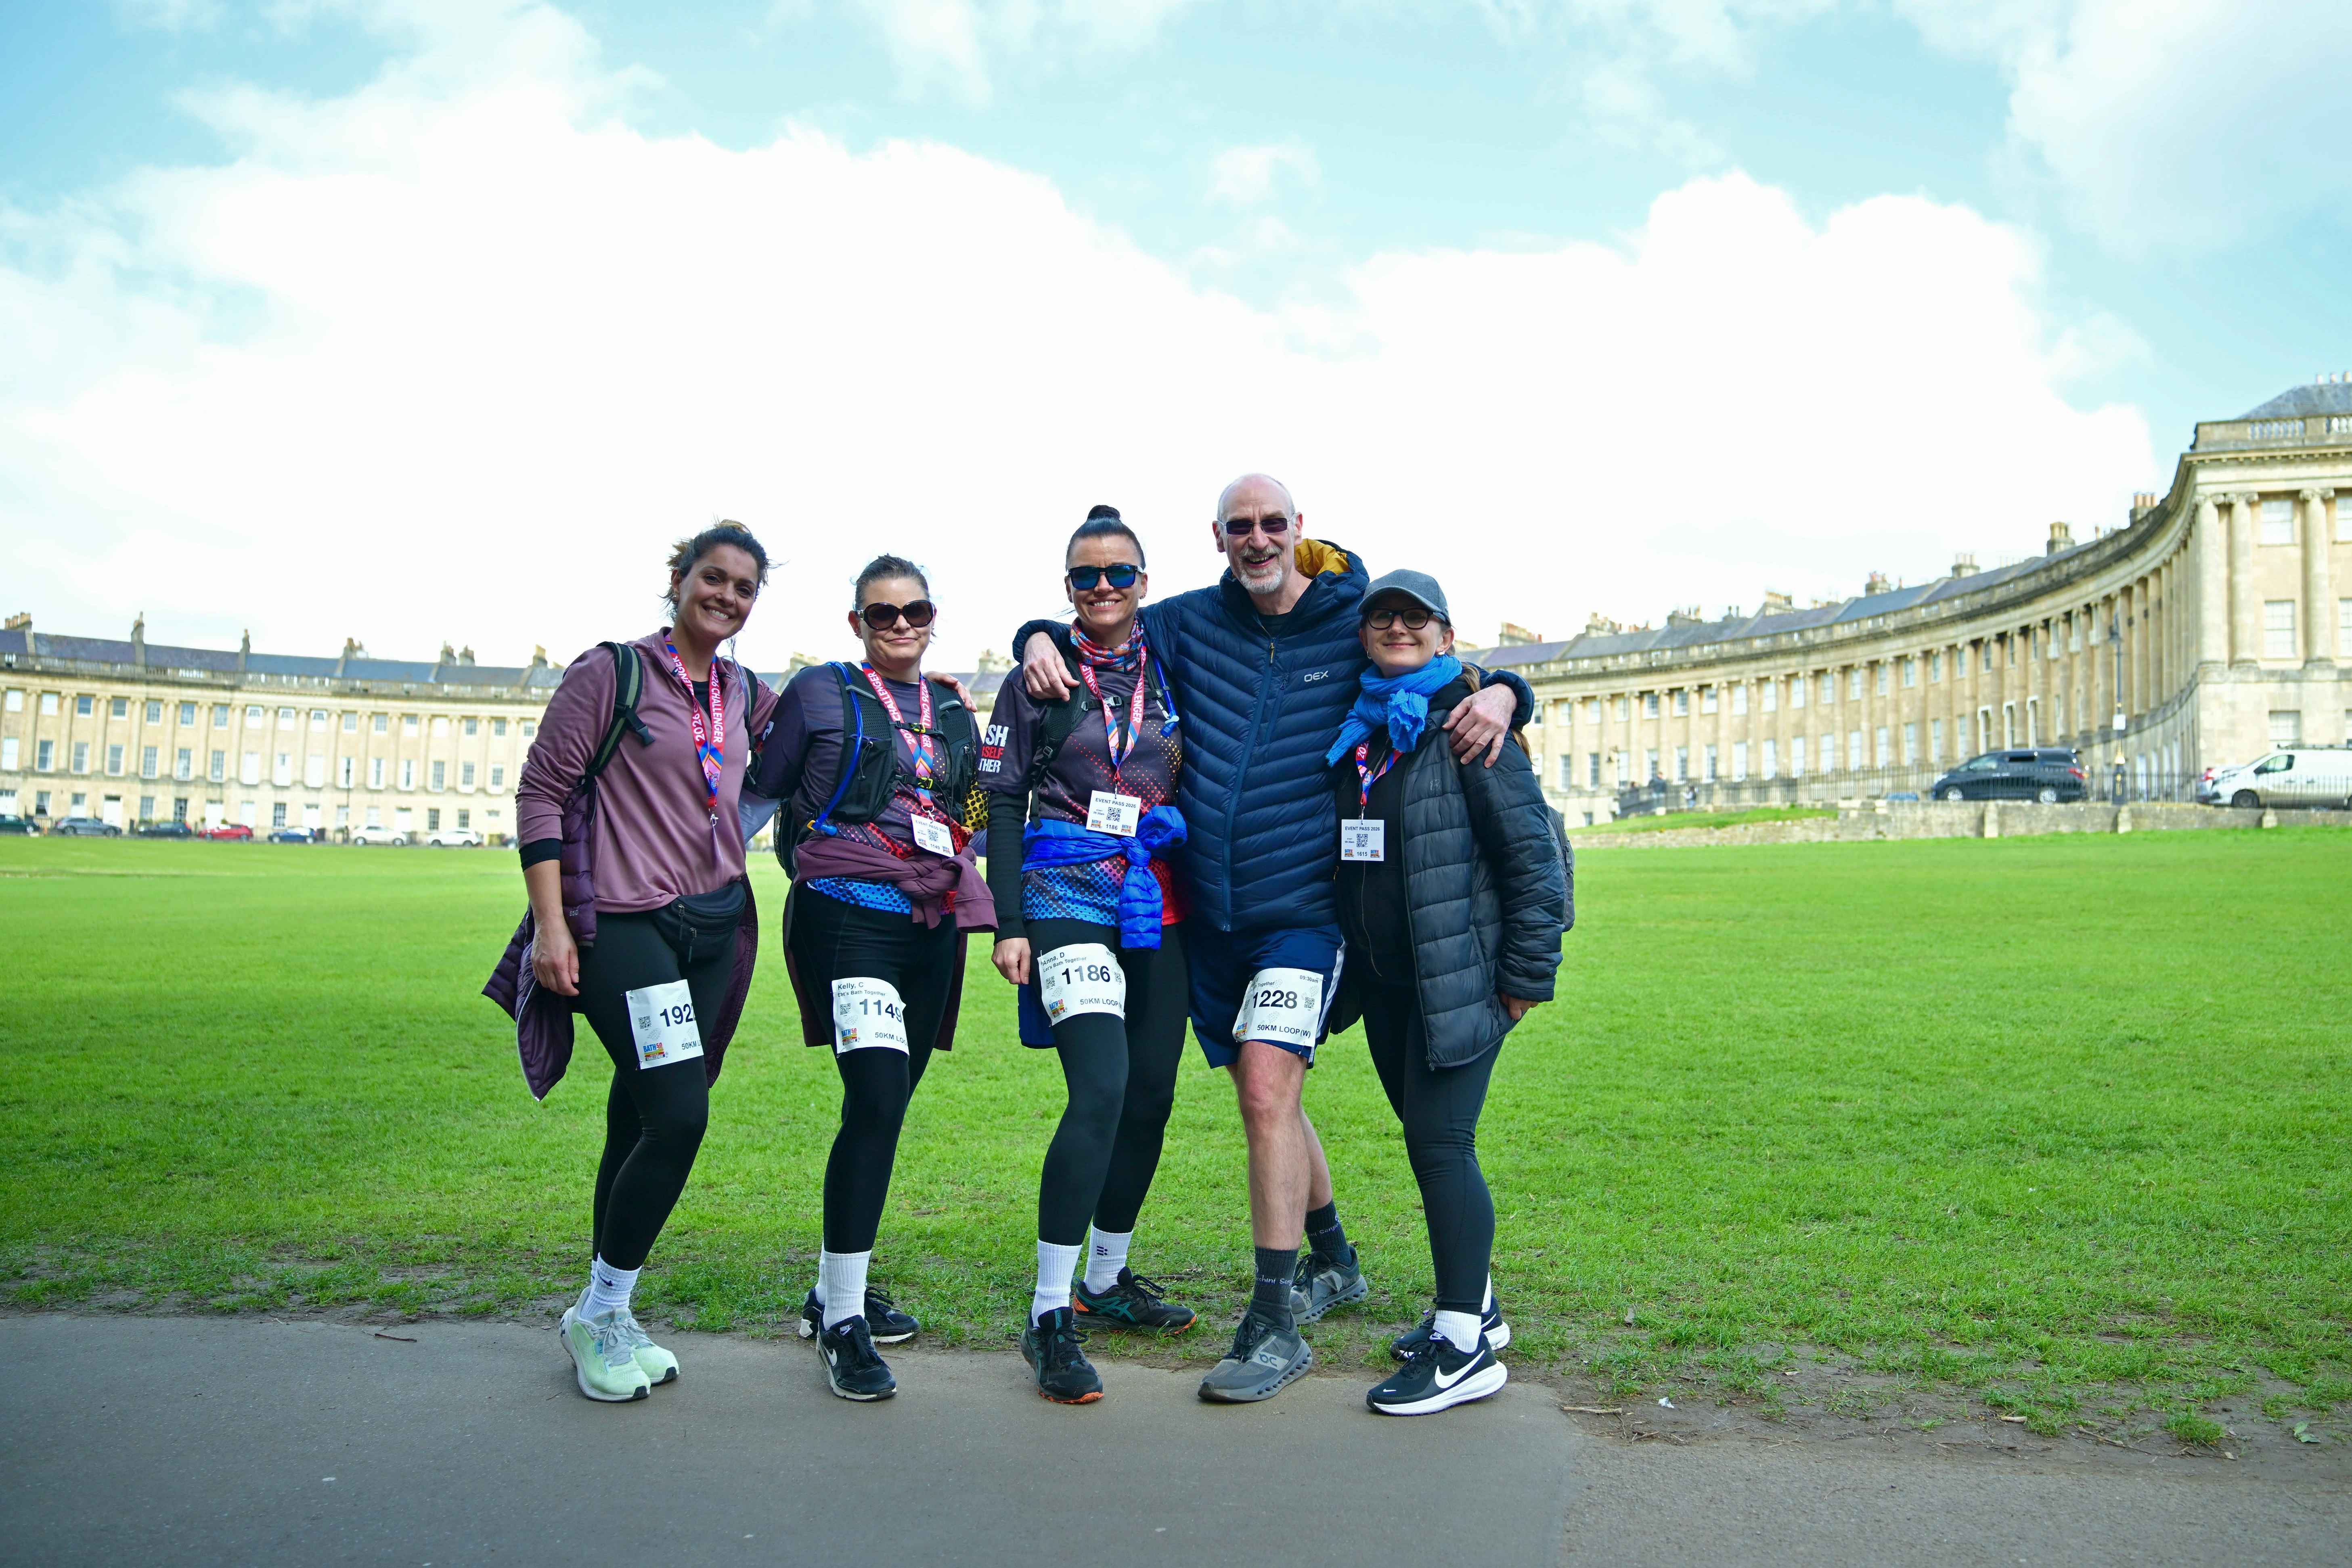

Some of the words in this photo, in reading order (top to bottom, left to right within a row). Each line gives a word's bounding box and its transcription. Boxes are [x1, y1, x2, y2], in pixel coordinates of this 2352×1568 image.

[1304, 670, 1328, 682] OEX
[868, 671, 901, 721] CHALLENGER
[712, 688, 723, 743] CHALLENGER
[692, 713, 705, 741] 2026
[1043, 956, 1058, 966] Anna,
[1062, 965, 1110, 984] 1186
[1300, 975, 1319, 984] 09:30am
[1253, 990, 1297, 1009] 1228
[859, 999, 902, 1023] 1149
[1049, 1001, 1058, 1010] BATH
[841, 1029, 851, 1037] BATH
[875, 1032, 894, 1040] 50KM
[643, 1043, 657, 1052] BATH
[682, 1041, 697, 1050] 50KM
